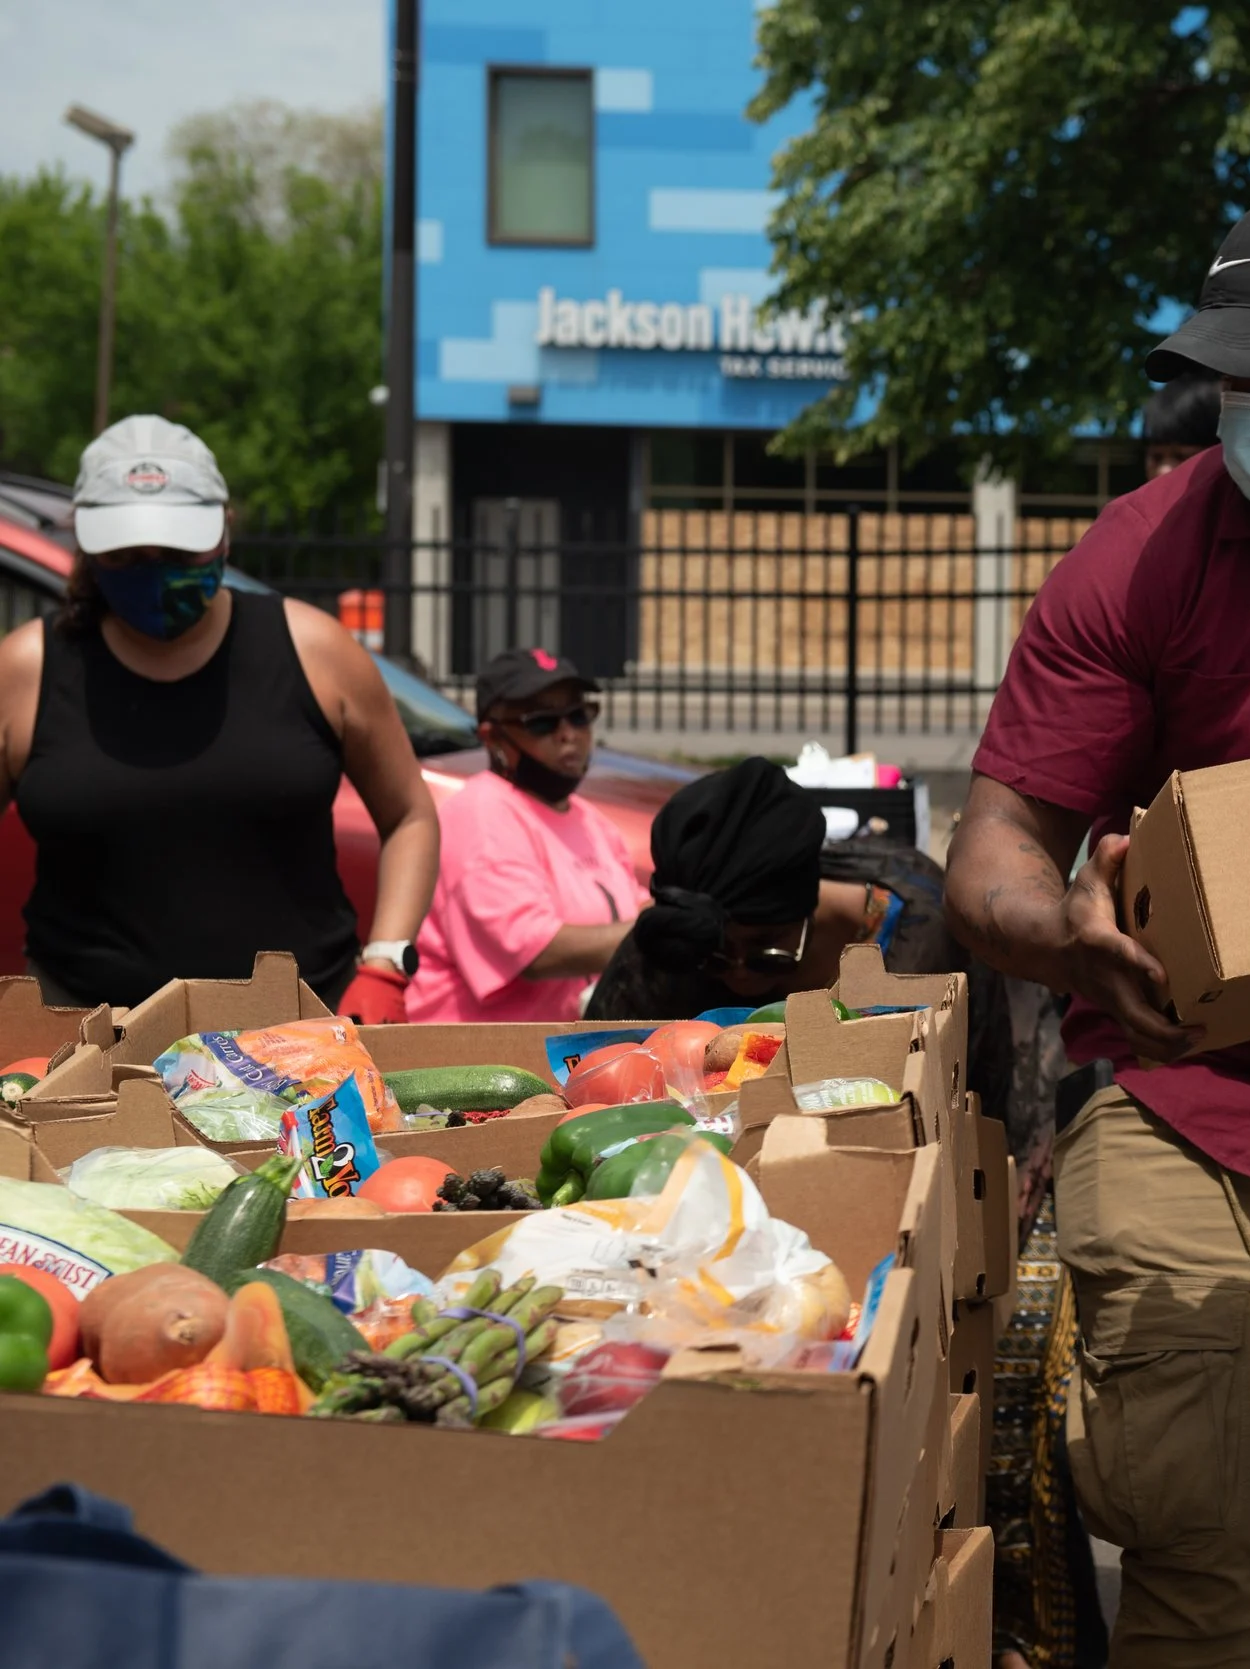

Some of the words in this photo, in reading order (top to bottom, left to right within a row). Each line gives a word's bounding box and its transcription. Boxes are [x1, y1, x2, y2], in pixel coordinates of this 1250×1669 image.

[536, 286, 713, 350] Jackson
[720, 356, 762, 378] TAX
[766, 356, 850, 380] SERVIC
[33, 1252, 97, 1289] MIST
